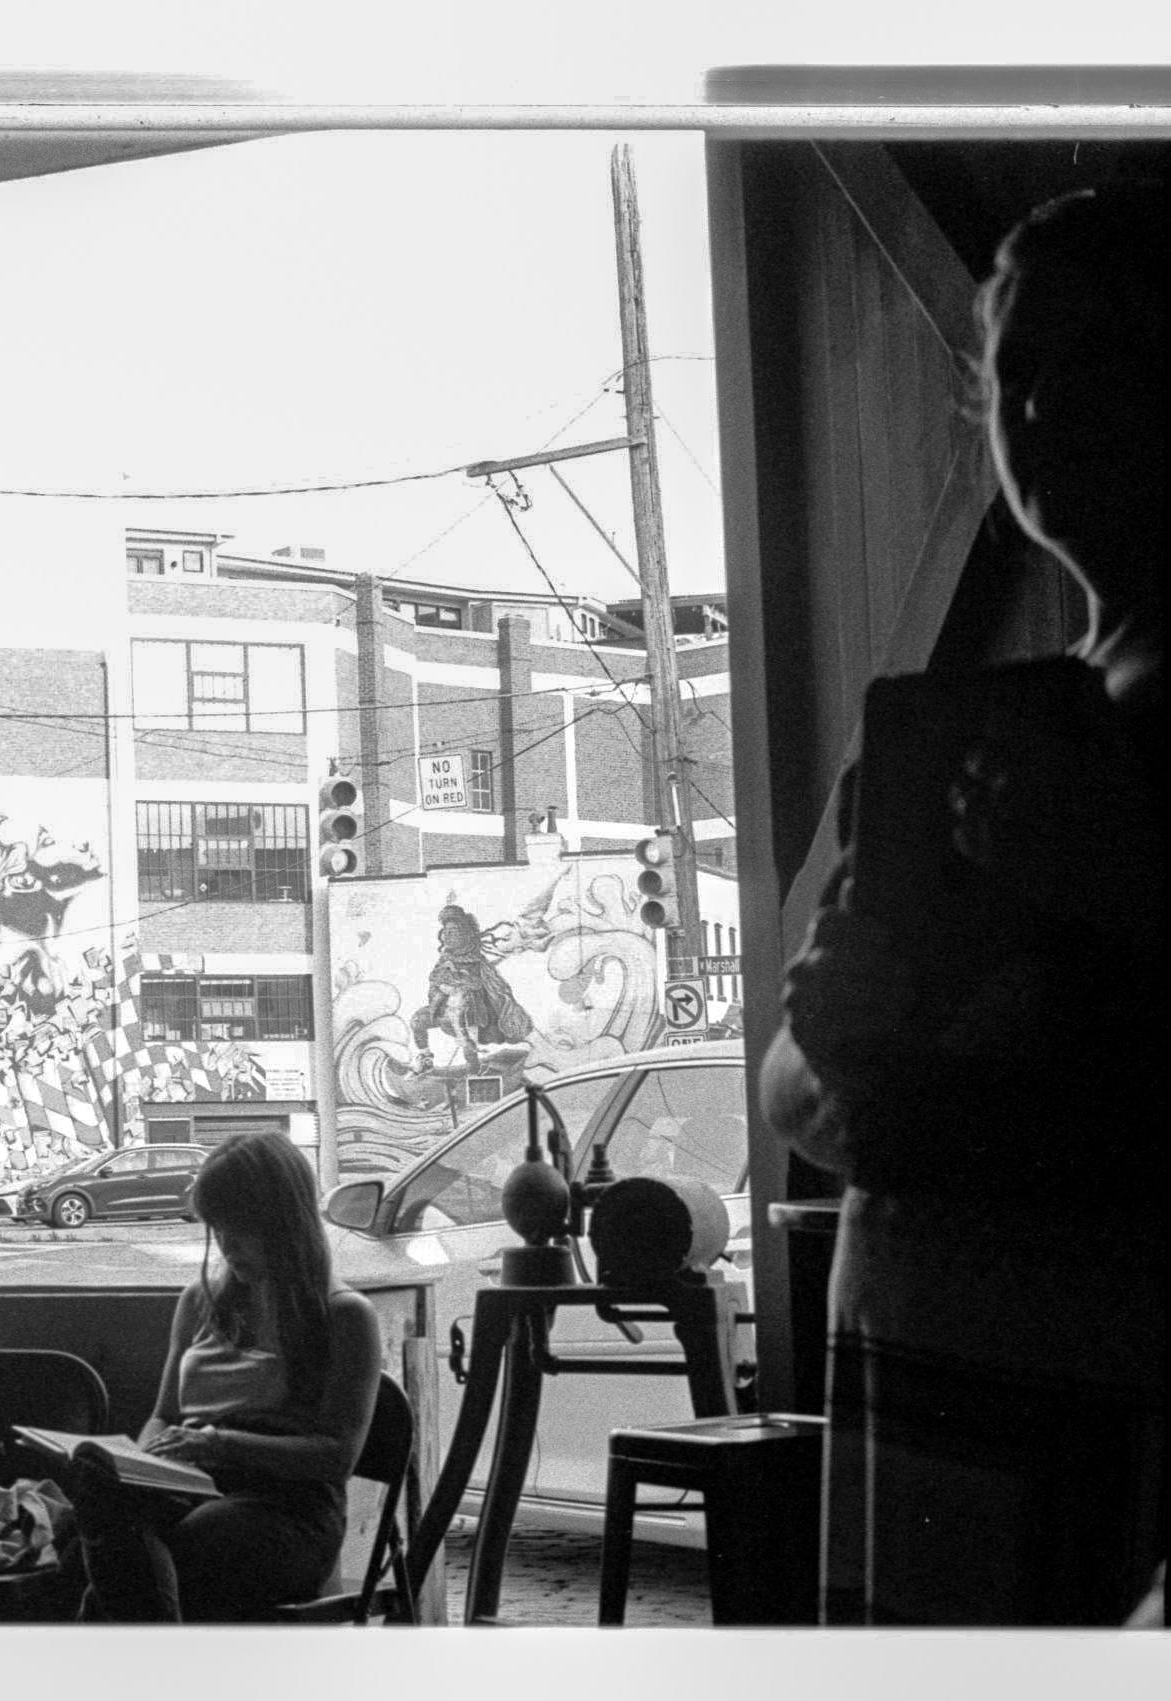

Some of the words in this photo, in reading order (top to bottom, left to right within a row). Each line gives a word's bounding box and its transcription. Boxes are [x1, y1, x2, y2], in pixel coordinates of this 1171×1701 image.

[432, 760, 450, 773] NO
[429, 777, 458, 789] TURN
[425, 794, 440, 806] ON
[443, 791, 464, 804] RED
[705, 958, 740, 974] Marshall
